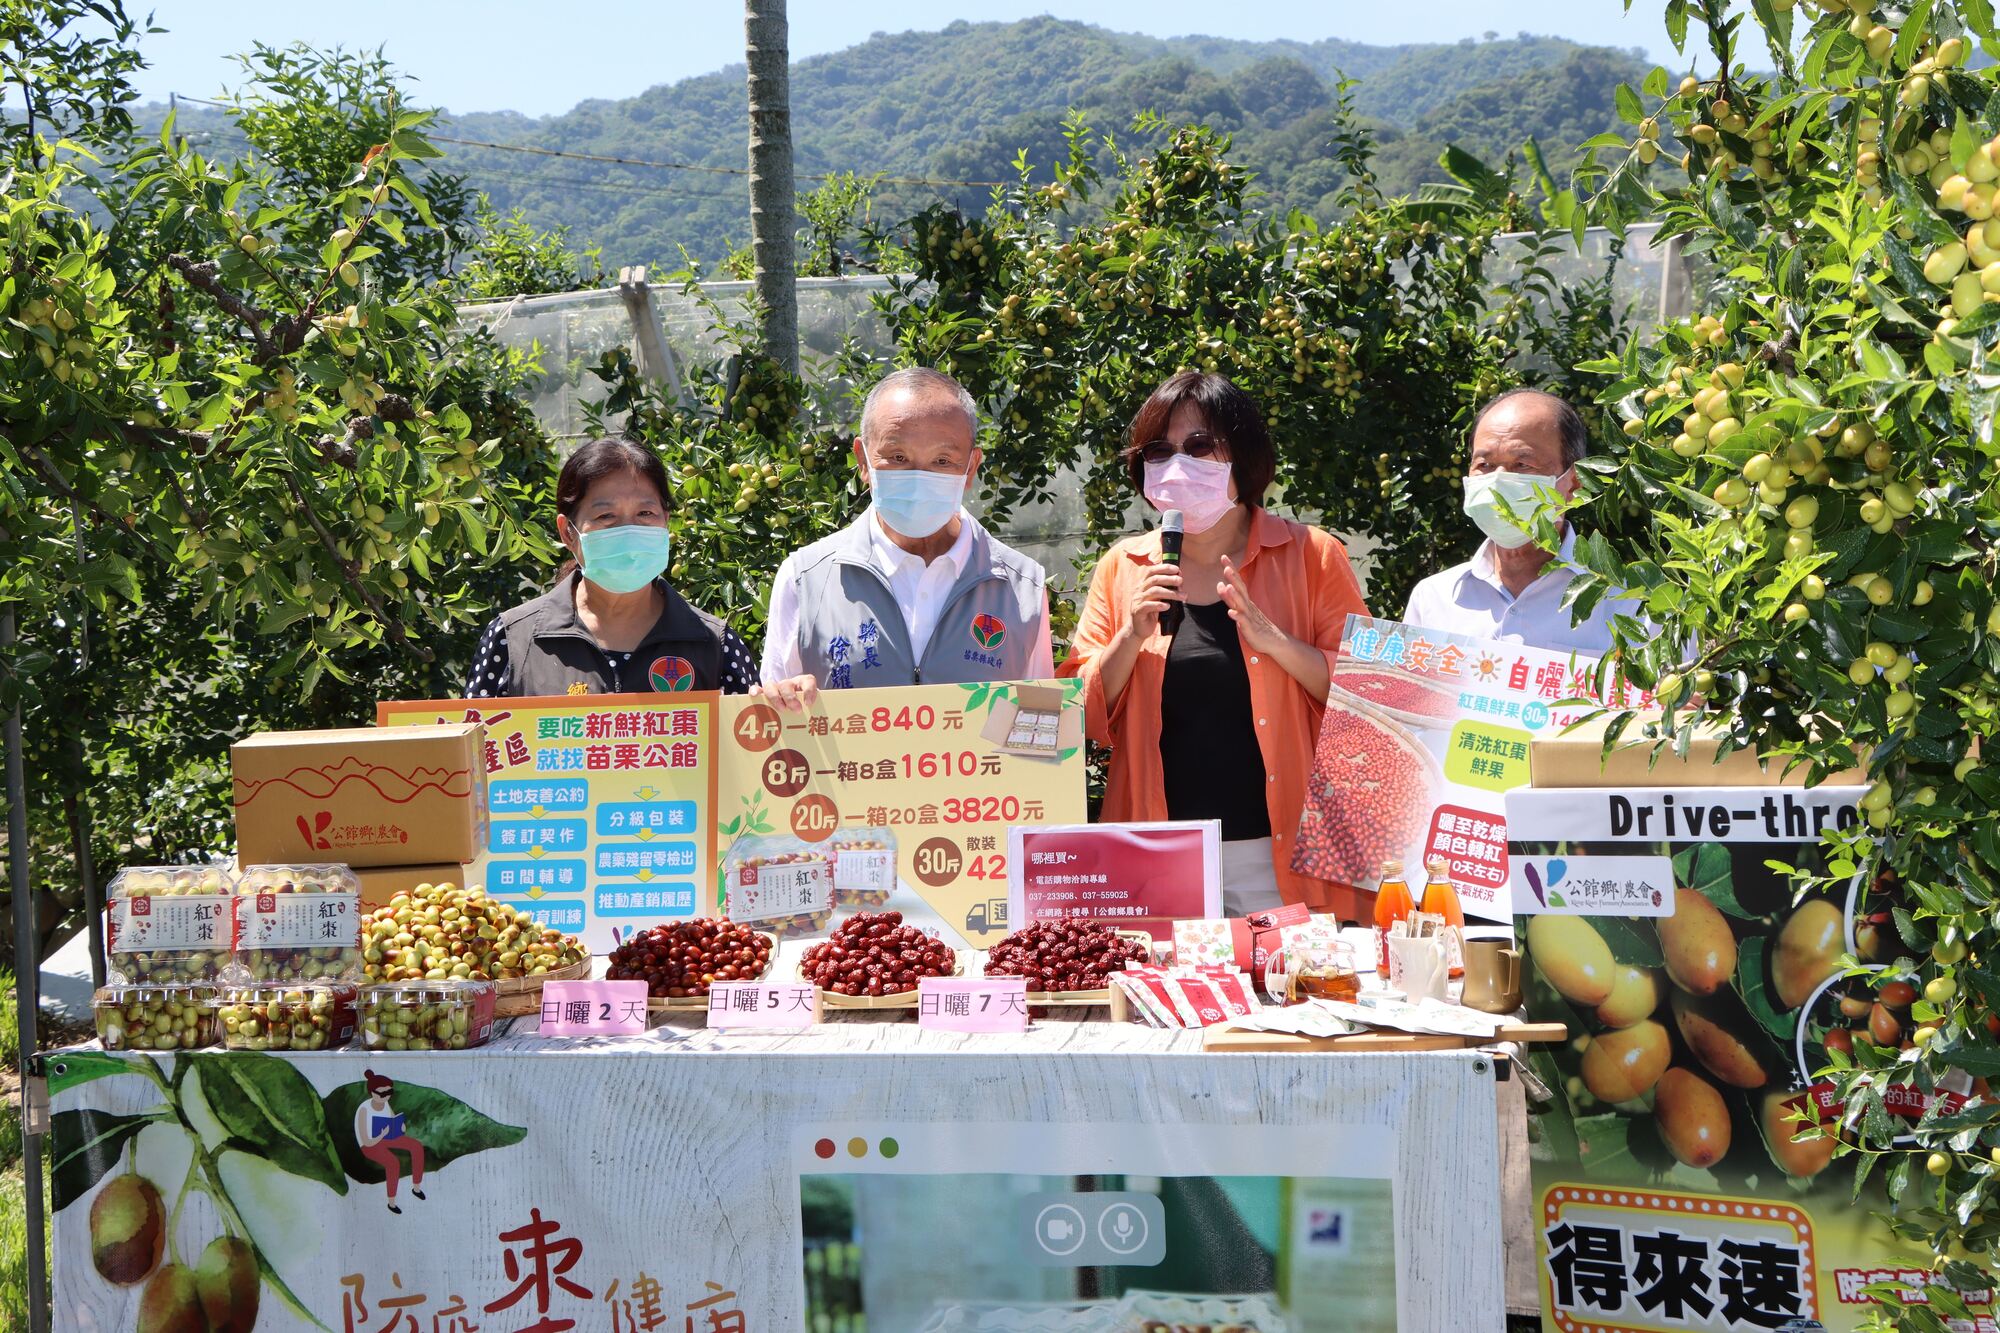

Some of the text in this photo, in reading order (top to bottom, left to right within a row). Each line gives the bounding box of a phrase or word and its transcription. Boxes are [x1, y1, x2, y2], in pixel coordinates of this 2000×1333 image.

[858, 618, 882, 670] 縣長
[1350, 628, 1465, 677] 健康安全
[963, 649, 1003, 670] 苗栗縣政府
[1457, 692, 1521, 719] 紅棗鮮果
[538, 710, 698, 739] 要吃新鮮紅棗
[738, 714, 779, 740] 4斤
[536, 742, 698, 771] 就找苗栗公館
[1458, 731, 1527, 761] 清洗紅棗
[768, 759, 808, 786] 8斤
[1470, 757, 1505, 779] 鮮果
[493, 787, 584, 804] 土地友善公約
[609, 810, 684, 828] 分級包裝
[796, 804, 837, 831] 20斤
[1438, 813, 1507, 844] 曬至乾燥
[1609, 794, 1868, 839] Drive-thro
[501, 828, 575, 845] 簽訂契作
[966, 836, 996, 851] 散裝
[1433, 832, 1502, 863] 顏色轉紅
[598, 850, 694, 868] 農藥殘留零檢出
[918, 848, 960, 875] 30斤
[500, 868, 574, 885] 田間輔導
[1036, 875, 1107, 885] 電話購物洽詢專線
[598, 891, 692, 908] 推動產銷履歷
[193, 903, 213, 941] 紅棗
[318, 901, 337, 939] 紅棗
[1547, 1222, 1806, 1327] 得來速
